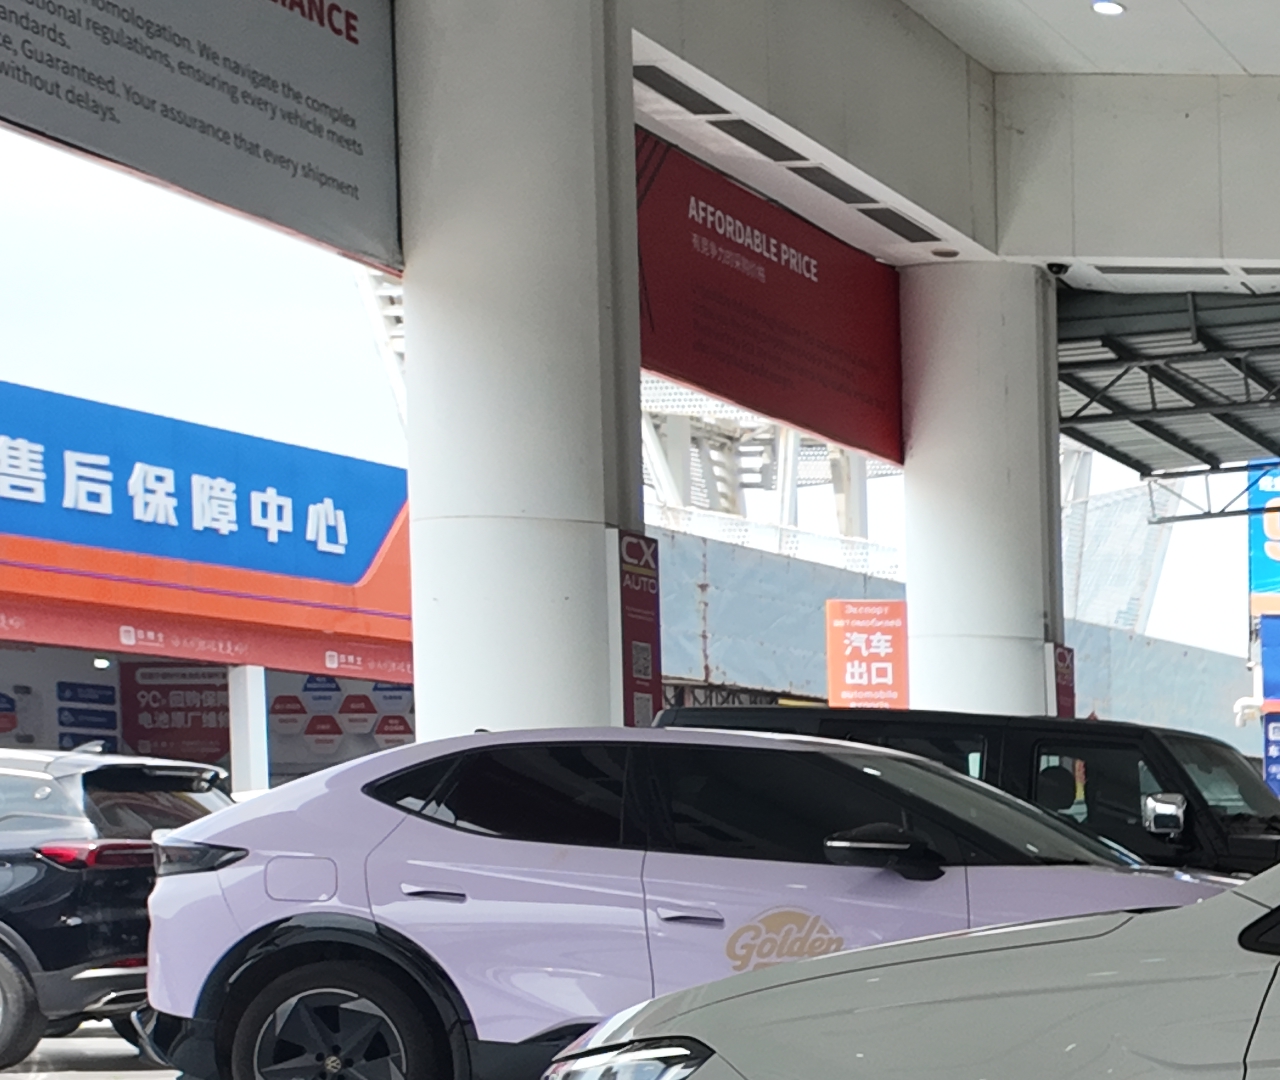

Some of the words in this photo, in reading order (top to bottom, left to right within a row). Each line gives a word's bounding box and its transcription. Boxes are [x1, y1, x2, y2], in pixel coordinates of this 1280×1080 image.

[271, 0, 359, 45] ANCE
[0, 60, 62, 100] without
[65, 85, 121, 124] delays.
[86, 16, 175, 74] regulations,
[177, 60, 240, 105] ensuring
[241, 88, 277, 121] every
[279, 107, 325, 139] vehicle
[327, 129, 364, 156] meets
[197, 40, 220, 66] We
[223, 56, 280, 94] navigate
[281, 81, 303, 105] the
[305, 95, 357, 130] complex
[21, 39, 121, 99] Guaranteed.
[122, 82, 157, 113] Your
[160, 102, 231, 146] assurance
[233, 131, 262, 160] that
[263, 148, 299, 178] every
[301, 162, 360, 200] shipment
[688, 196, 779, 263] AFFORDABLE
[780, 243, 819, 283] PRICE
[0, 434, 349, 555] 售后保障中心
[621, 535, 657, 569] CX
[623, 574, 658, 595] AUTO
[843, 631, 893, 657] 汽车
[845, 660, 893, 685] 出口
[726, 915, 845, 971] Golden
